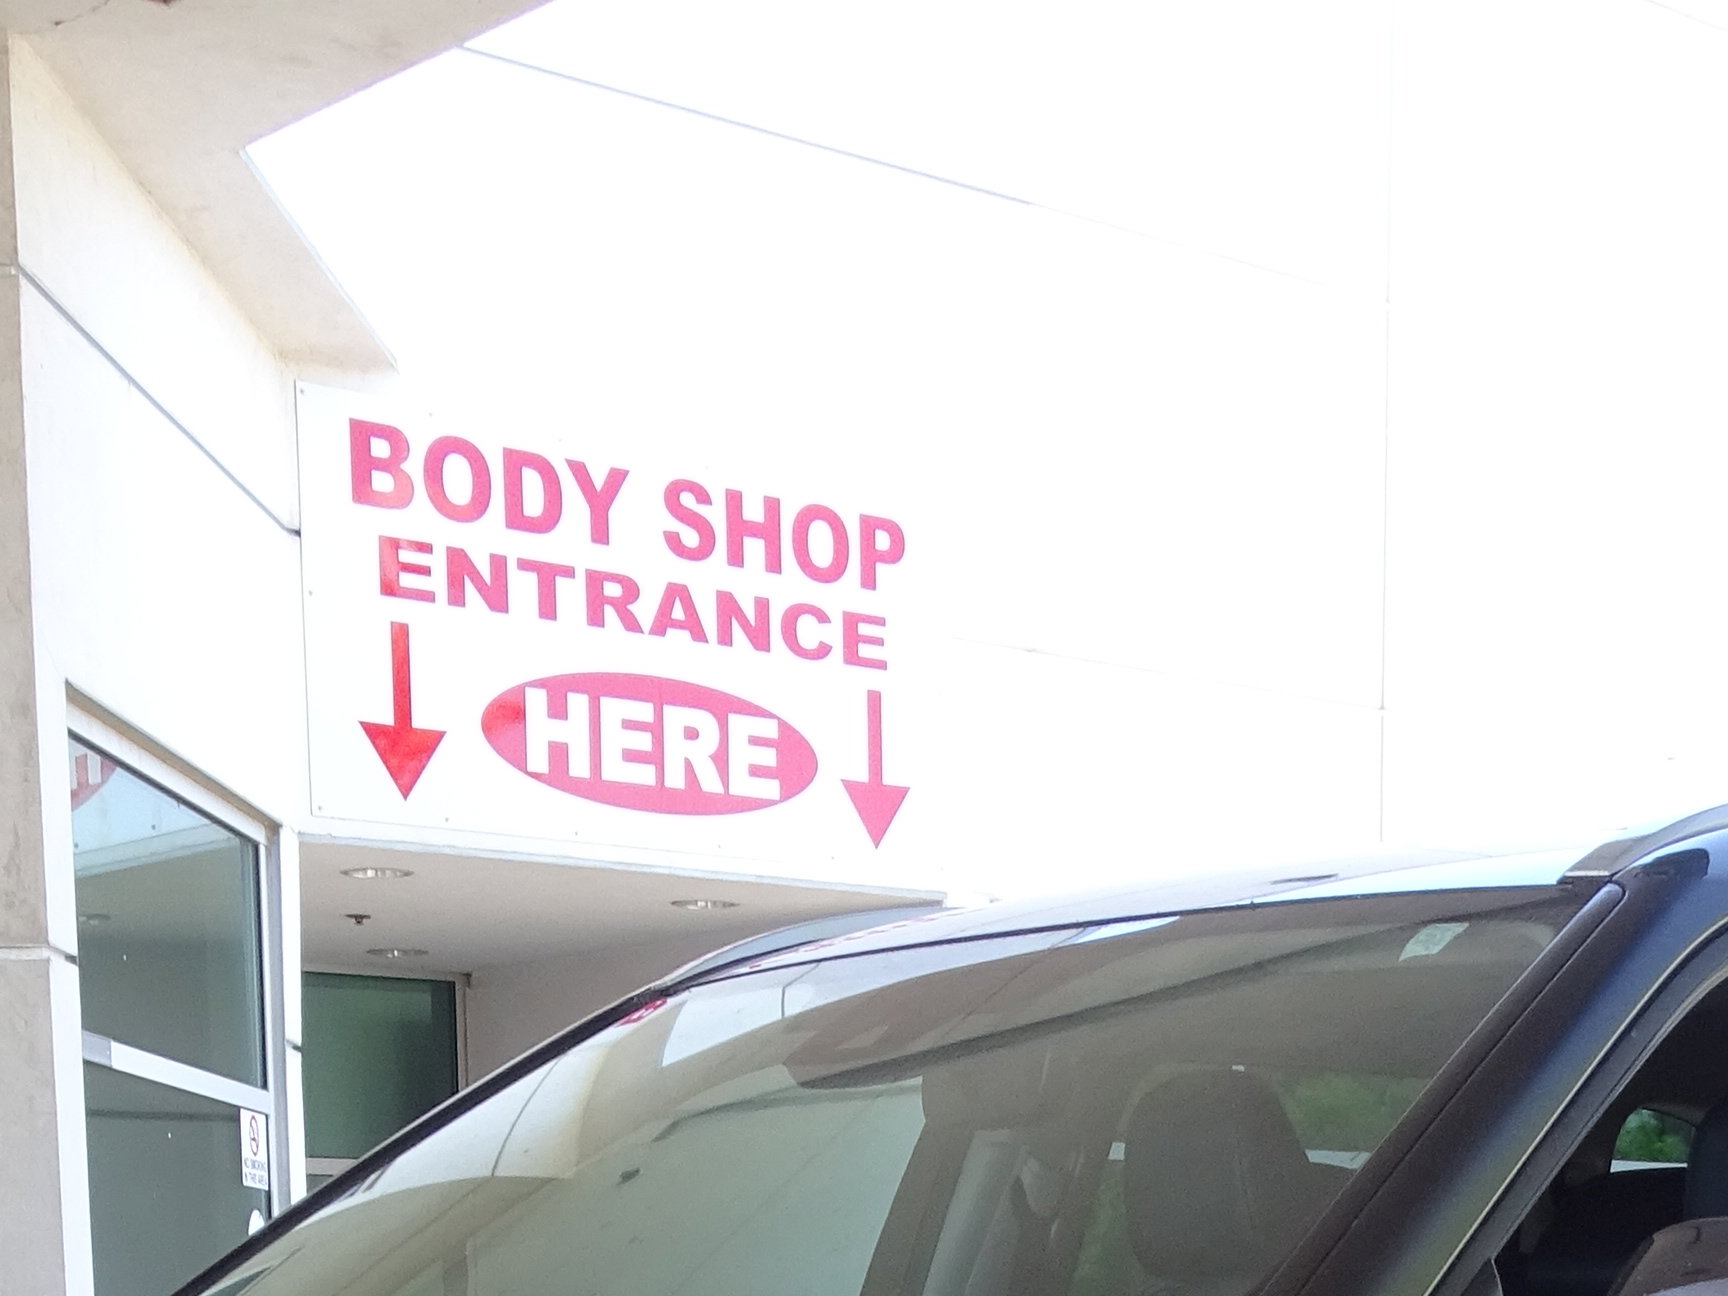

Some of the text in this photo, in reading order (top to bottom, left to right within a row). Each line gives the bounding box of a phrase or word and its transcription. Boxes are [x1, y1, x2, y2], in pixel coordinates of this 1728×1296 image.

[349, 417, 906, 591] BODY SHOP
[378, 535, 888, 671] ENTRANCE
[524, 686, 781, 800] HERE
